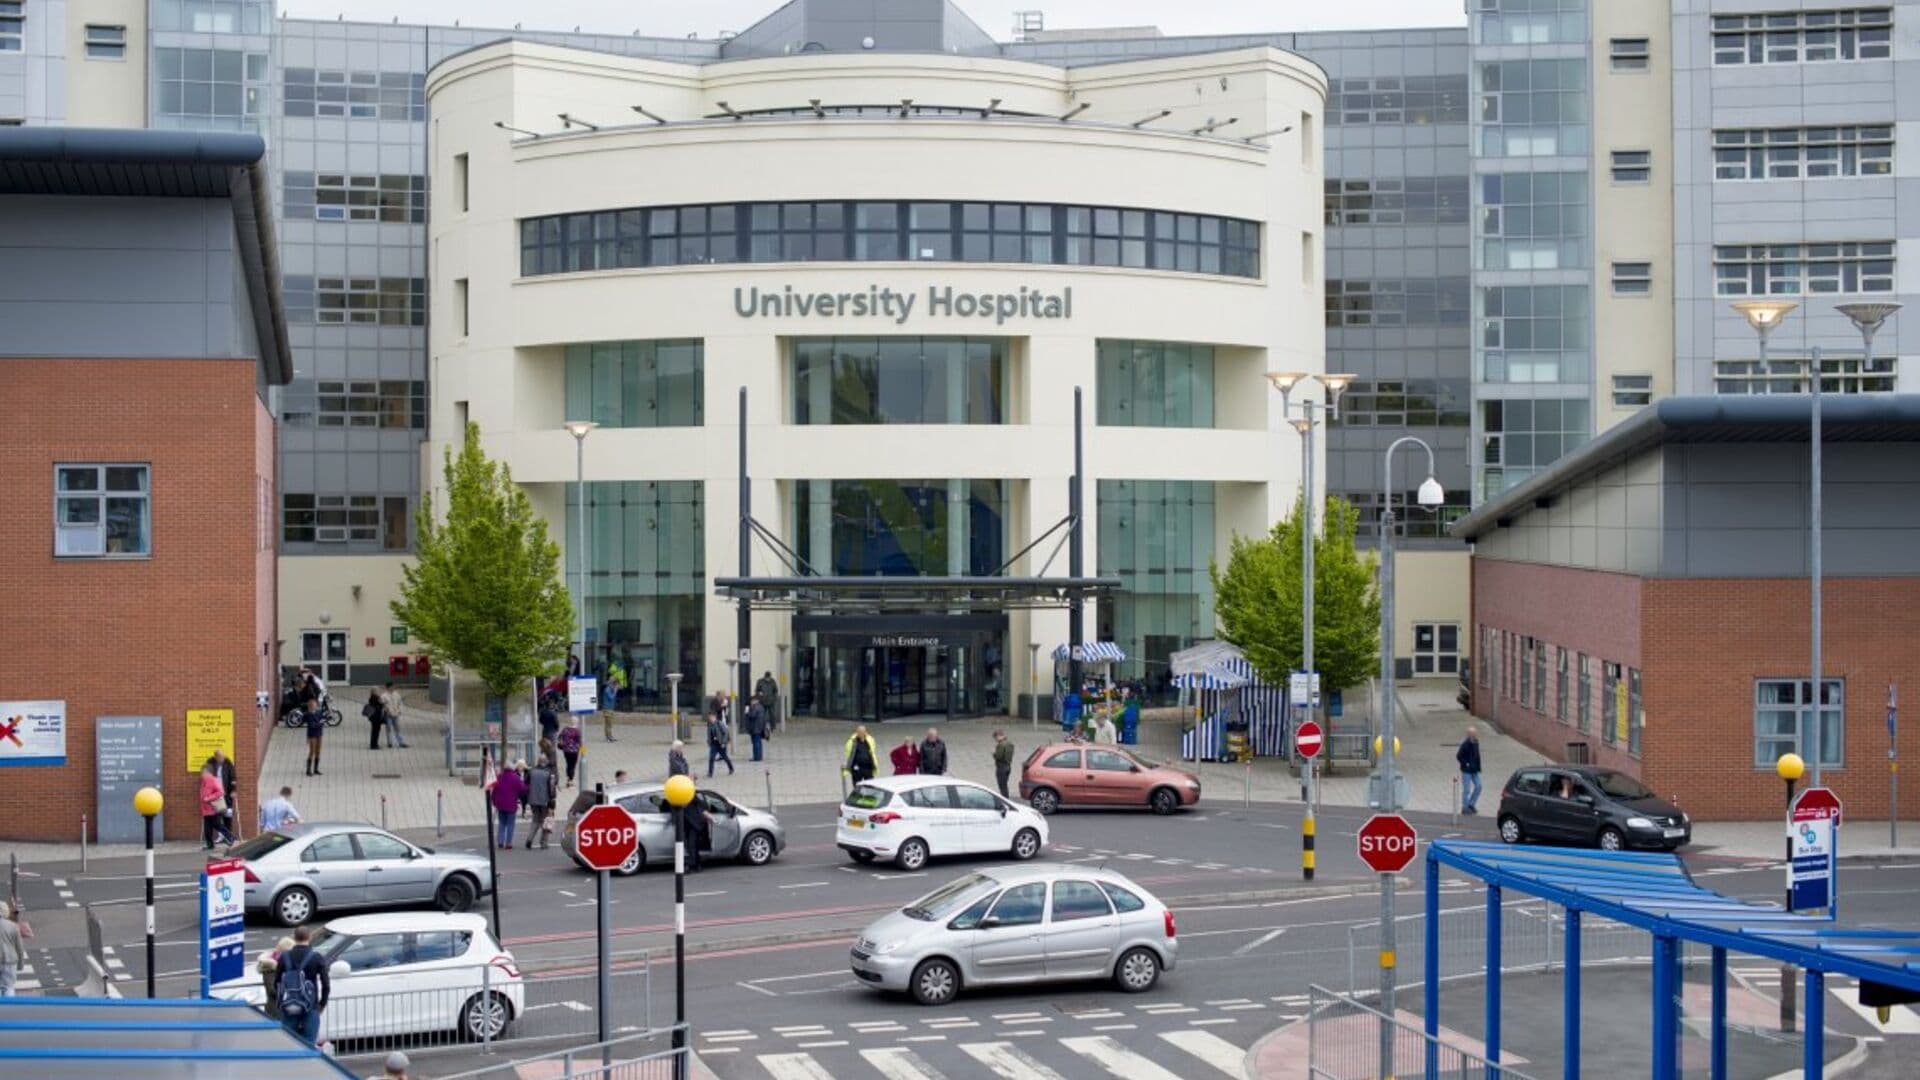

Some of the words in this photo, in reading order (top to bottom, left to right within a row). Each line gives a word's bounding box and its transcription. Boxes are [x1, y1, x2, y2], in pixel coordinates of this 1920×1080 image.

[734, 285, 916, 324] University
[929, 285, 1072, 324] Hospital
[872, 636, 896, 646] Main
[898, 636, 939, 646] Entrance
[580, 827, 635, 847] STOP
[1361, 835, 1414, 852] STOP
